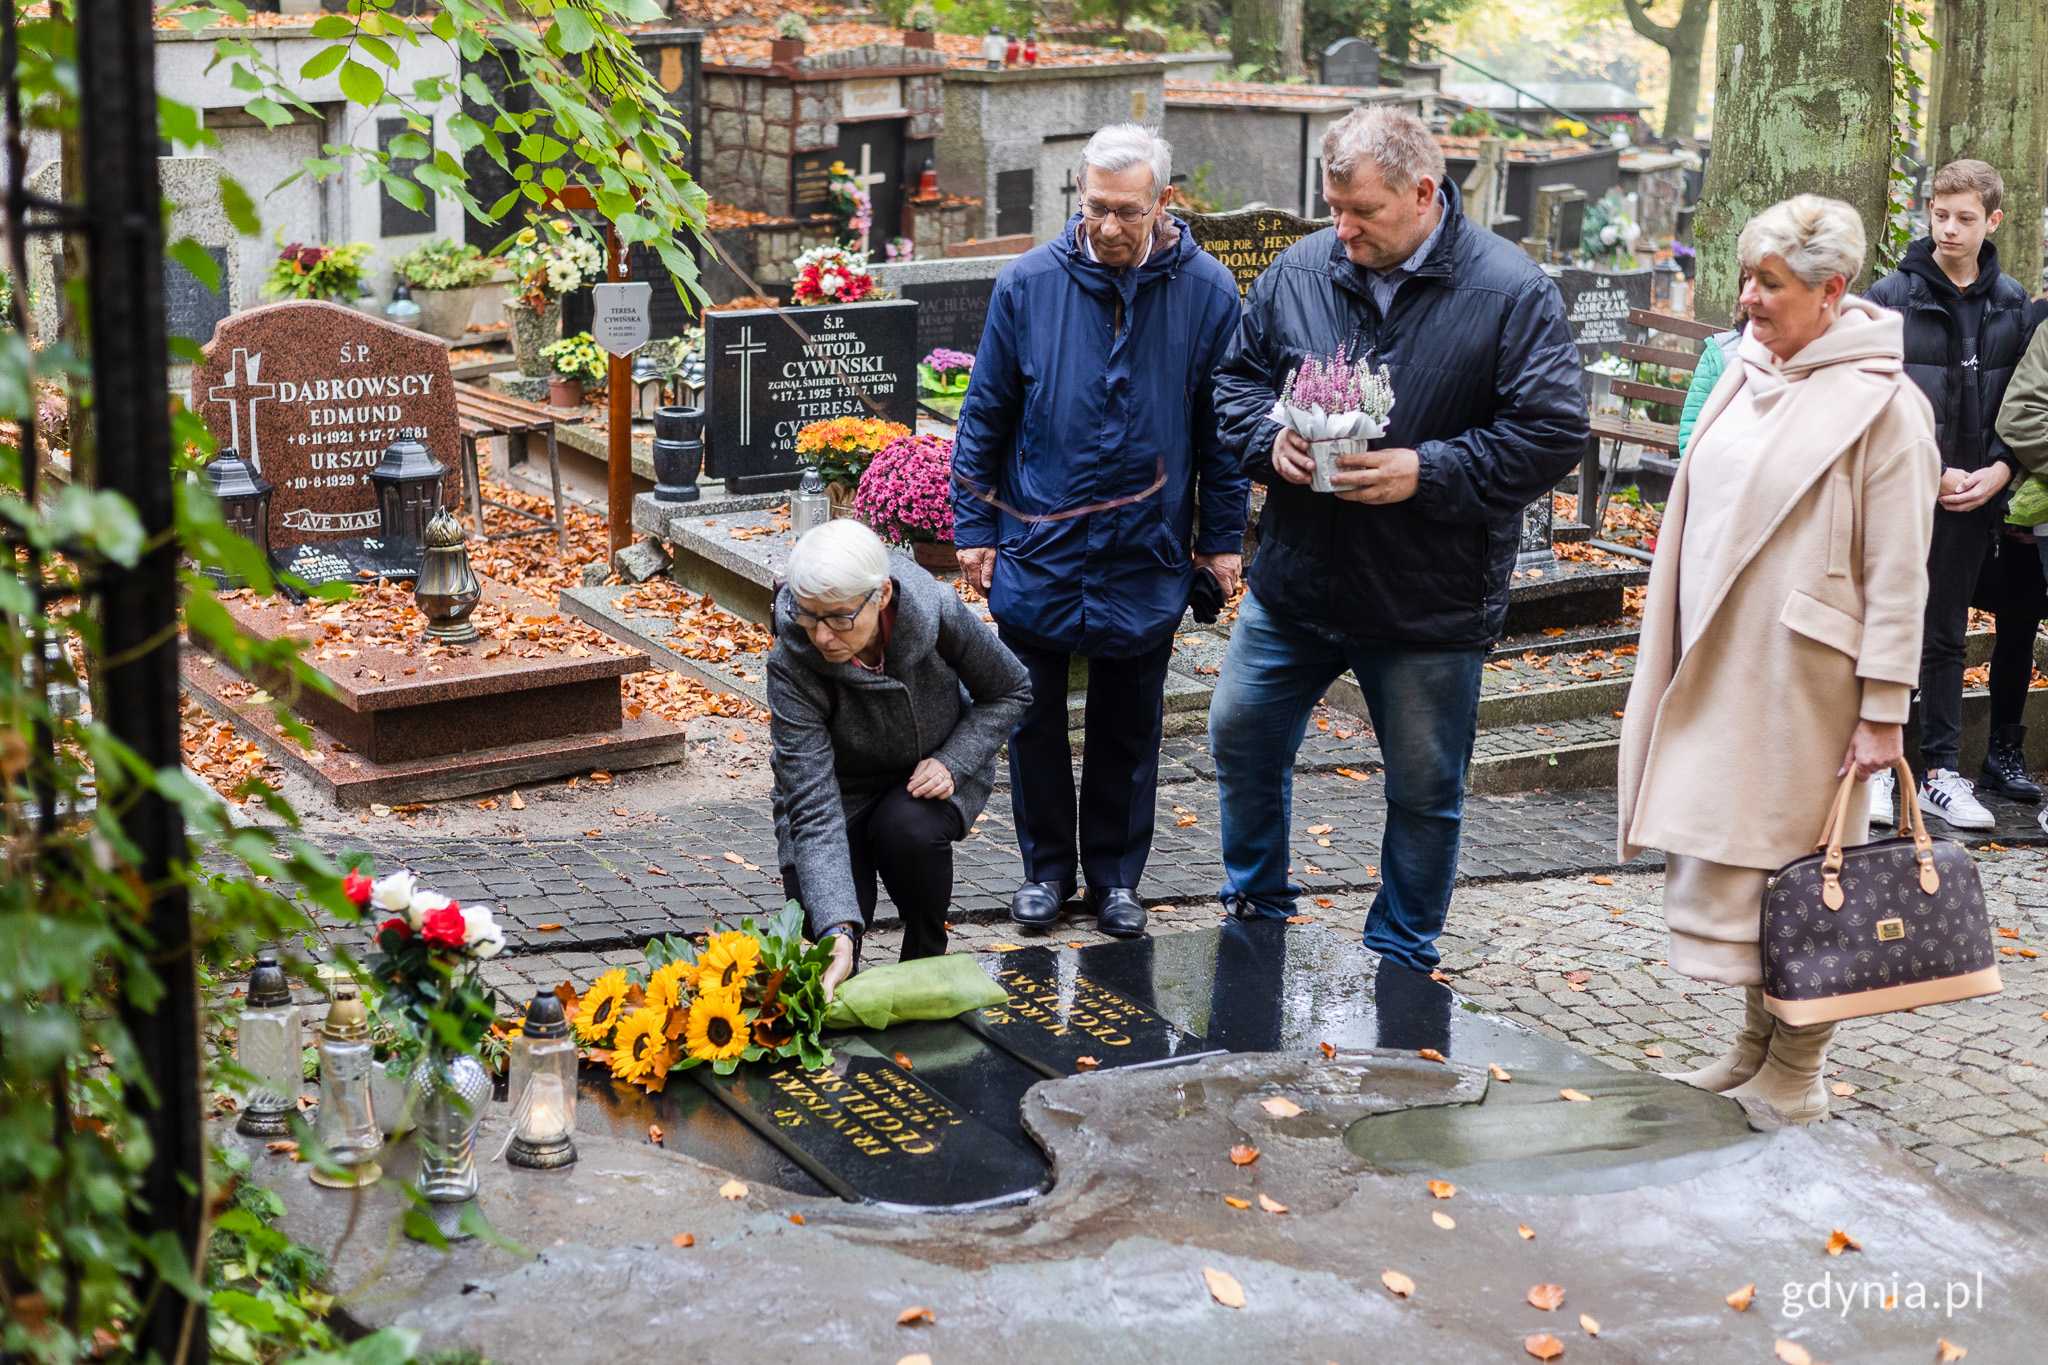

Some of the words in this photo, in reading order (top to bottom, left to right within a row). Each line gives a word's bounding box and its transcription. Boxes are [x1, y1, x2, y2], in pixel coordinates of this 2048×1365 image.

[1204, 240, 1230, 251] KMDR
[1573, 299, 1630, 314] SOBCZAK
[604, 315, 641, 323] CYWIŃSKA
[823, 314, 844, 330] Ś.P.
[810, 333, 836, 343] KMDR
[838, 332, 857, 341] POR.
[340, 342, 370, 363] Ś.P.
[802, 341, 866, 358] WITOLD
[783, 355, 884, 378] CYWIŃSKI
[279, 374, 435, 405] DĄBROWSCY
[768, 379, 802, 390] ZGINĄŁ
[803, 377, 846, 388] ŚMIERCIĄ
[848, 373, 897, 384] TRAGICZNĄ
[310, 405, 402, 426] EDMUND
[798, 400, 864, 417] TERESA
[301, 516, 331, 529] AVE
[340, 512, 381, 529] MARI
[768, 1070, 891, 1156] FRANCISZKA
